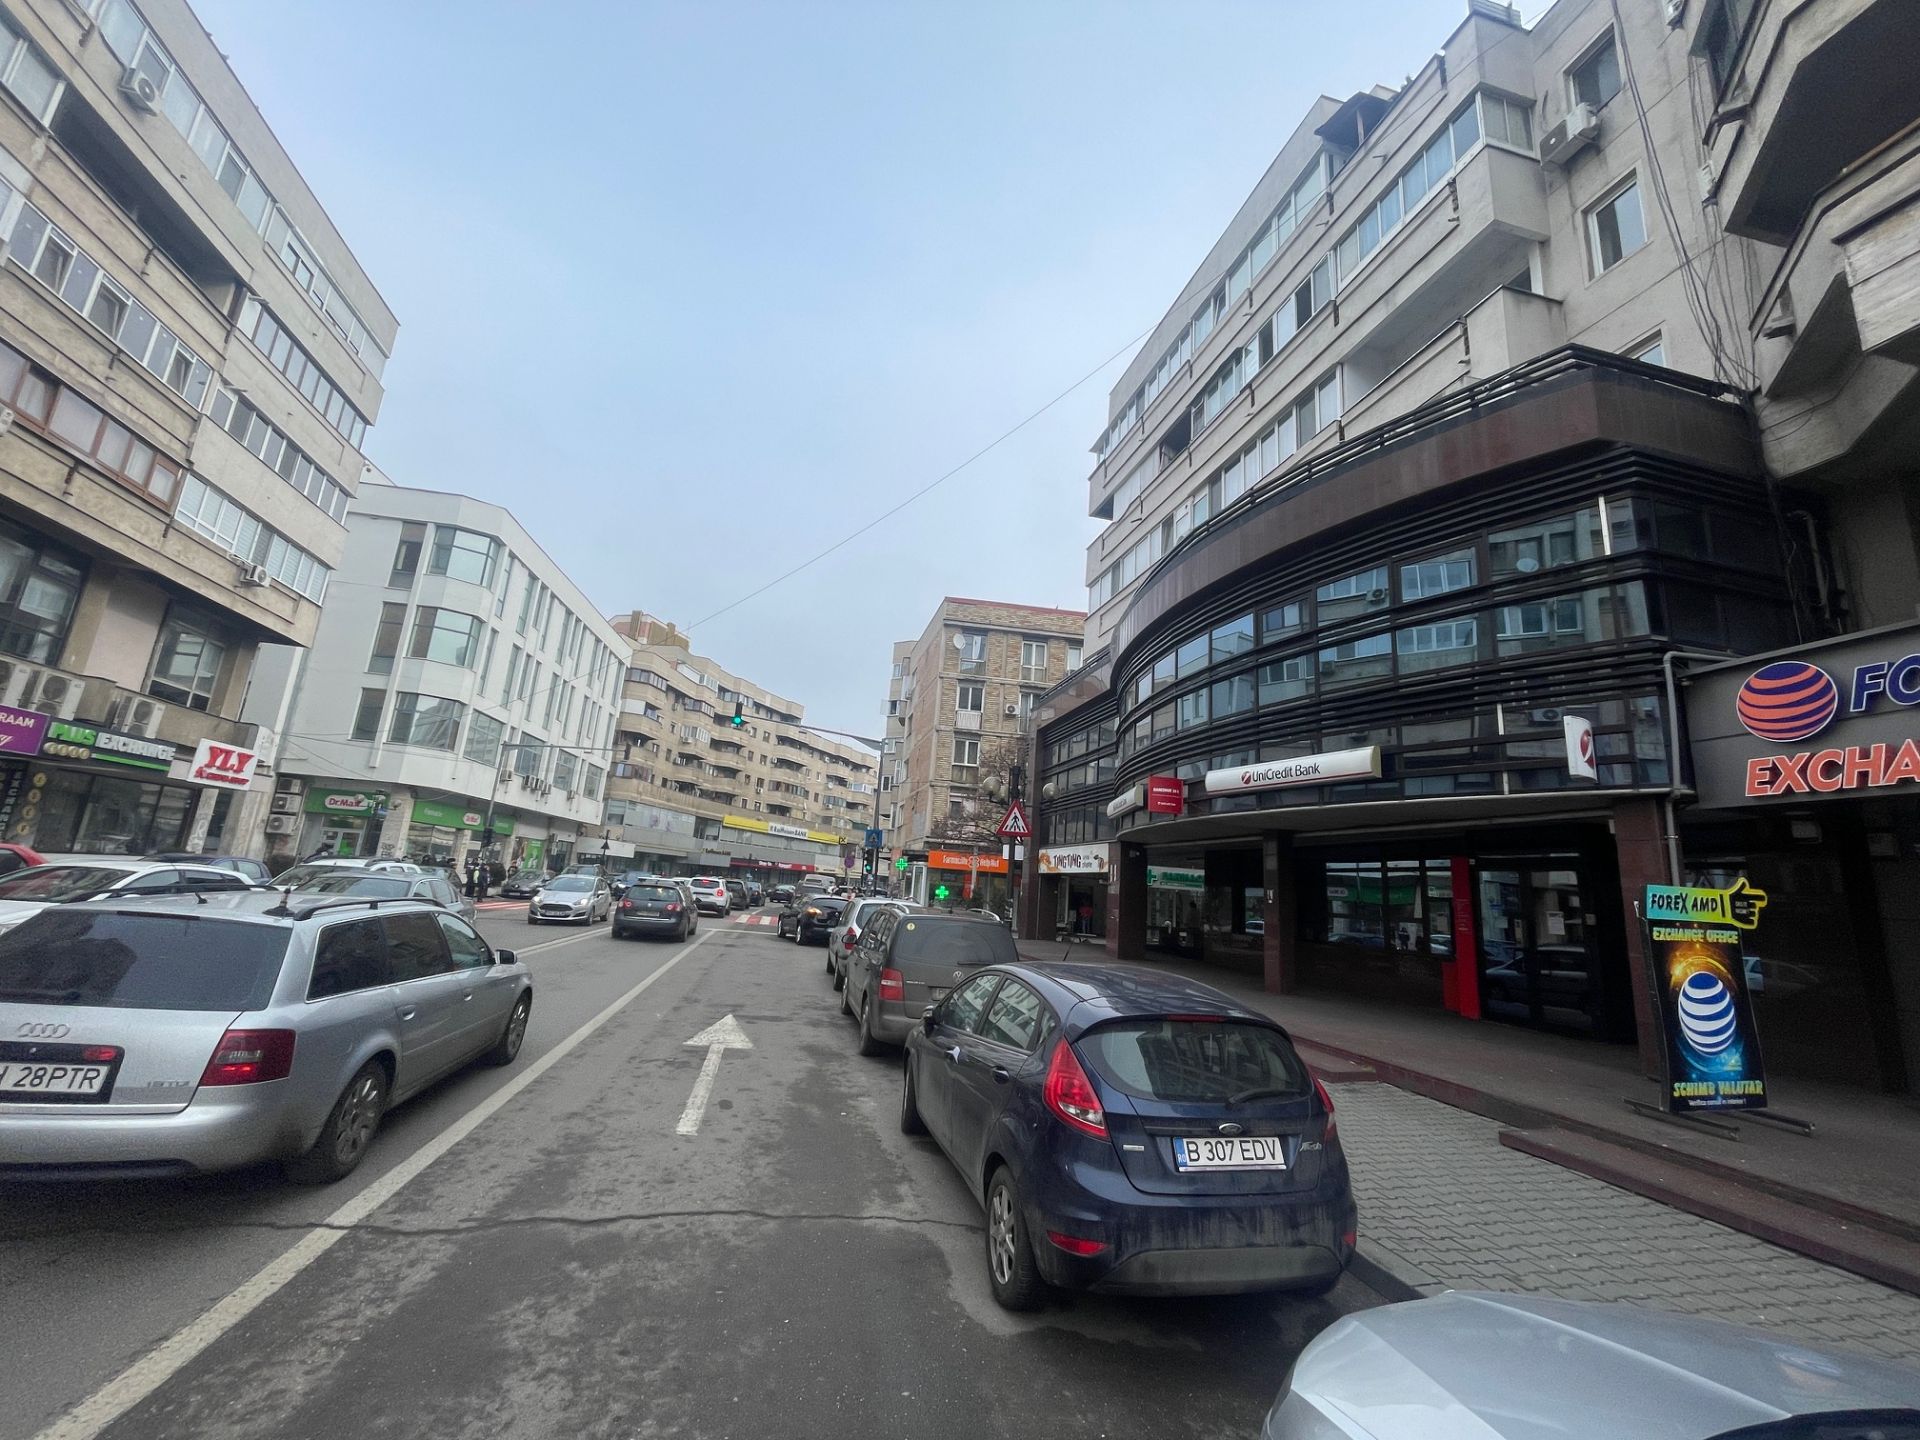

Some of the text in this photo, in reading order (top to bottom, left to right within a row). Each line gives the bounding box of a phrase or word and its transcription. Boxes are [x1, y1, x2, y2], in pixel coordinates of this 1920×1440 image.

[48, 721, 97, 746] PLUS
[1252, 762, 1321, 782] UniCredit Bank
[1651, 892, 1688, 914] FOREX
[1691, 897, 1718, 912] AMD
[1653, 927, 1738, 944] EXCHANGE OFFICE
[1673, 1080, 1763, 1097] SCHIMB VALUTAR
[1185, 1140, 1200, 1162] B
[1204, 1140, 1235, 1162] 307
[1239, 1139, 1276, 1162] EDV
